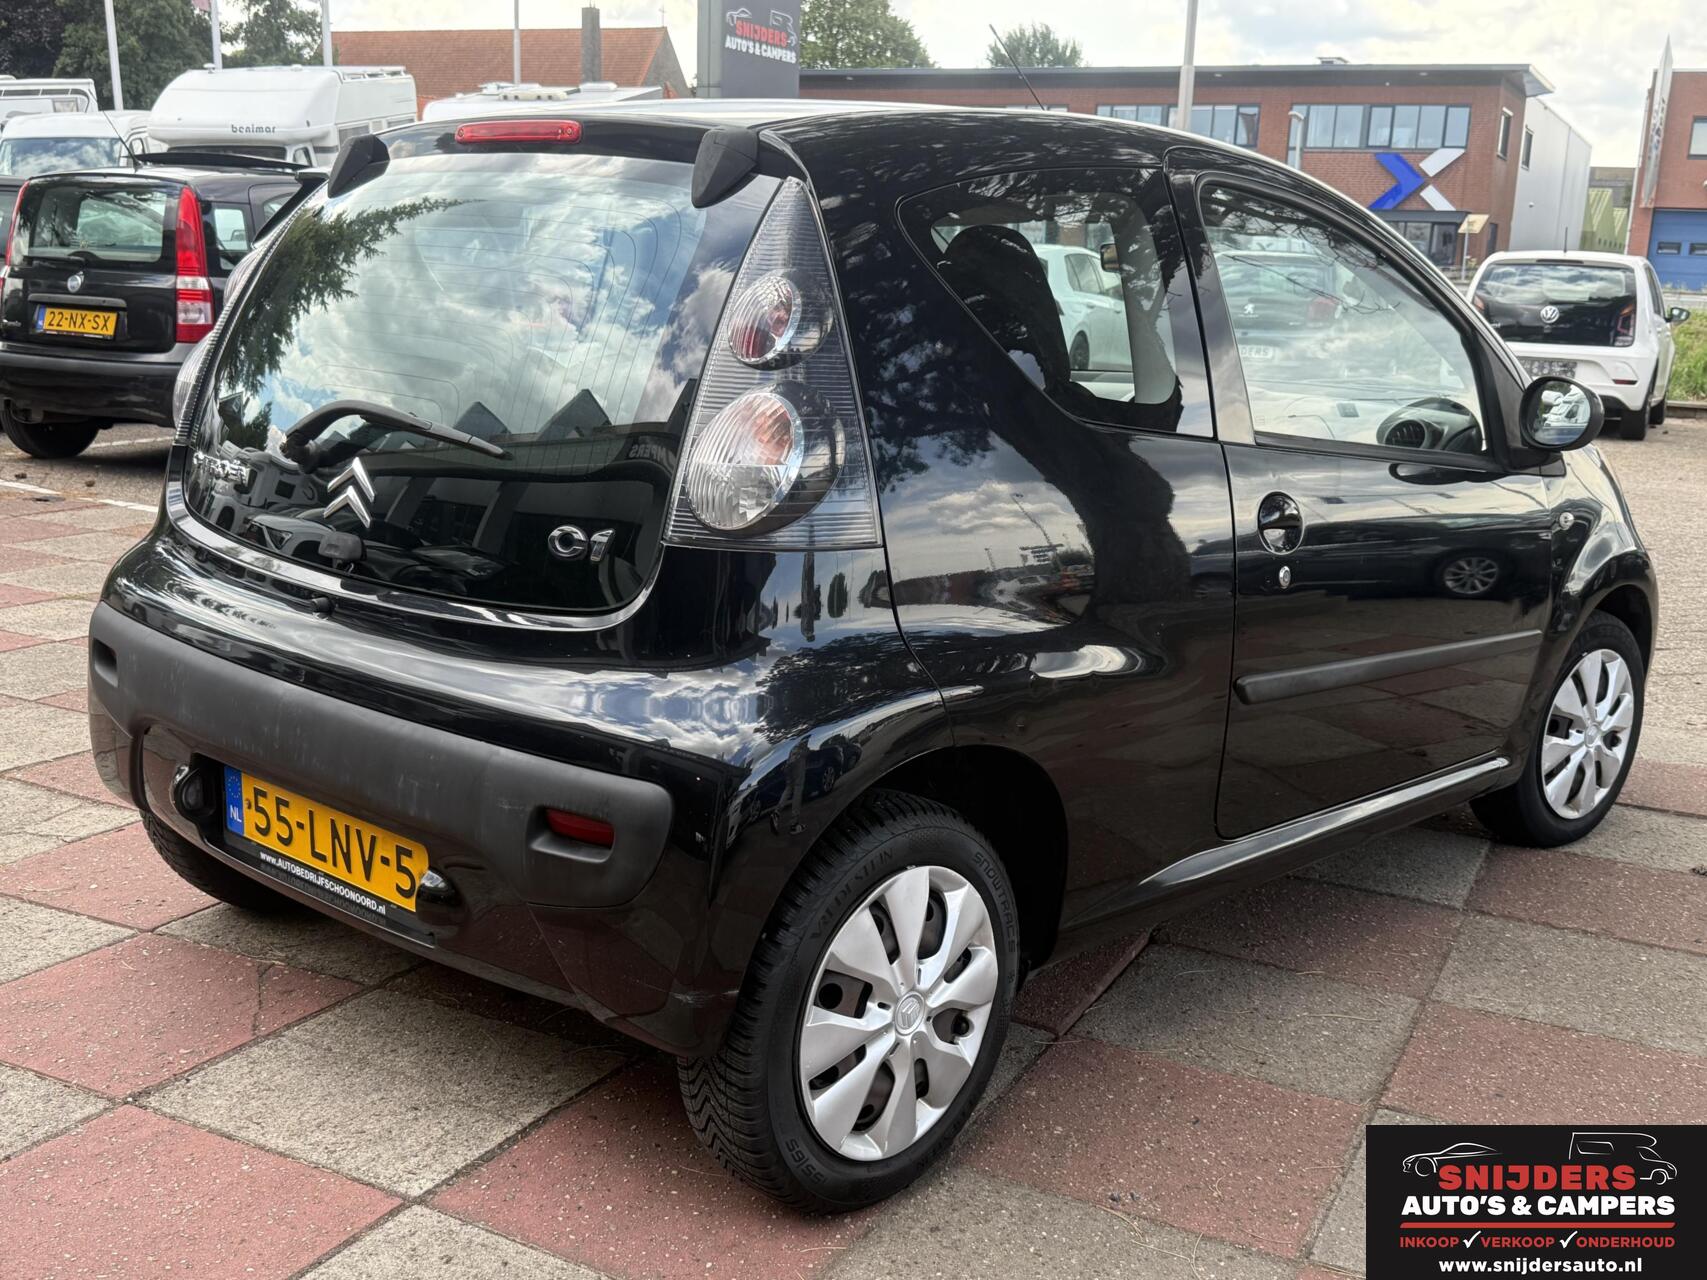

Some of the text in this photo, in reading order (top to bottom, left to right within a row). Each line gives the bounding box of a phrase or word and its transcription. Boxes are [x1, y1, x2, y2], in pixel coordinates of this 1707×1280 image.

[735, 19, 788, 48] SNIJDERS
[725, 35, 754, 54] AUTO'S
[761, 43, 797, 63] CAMPERS
[47, 311, 110, 332] 22-NX-SX
[548, 526, 614, 562] C1
[229, 804, 242, 823] NL
[253, 786, 416, 898] 55-LNV-5
[260, 851, 386, 915] www.AUTOBEDRIJFSCHOONOORD.nl
